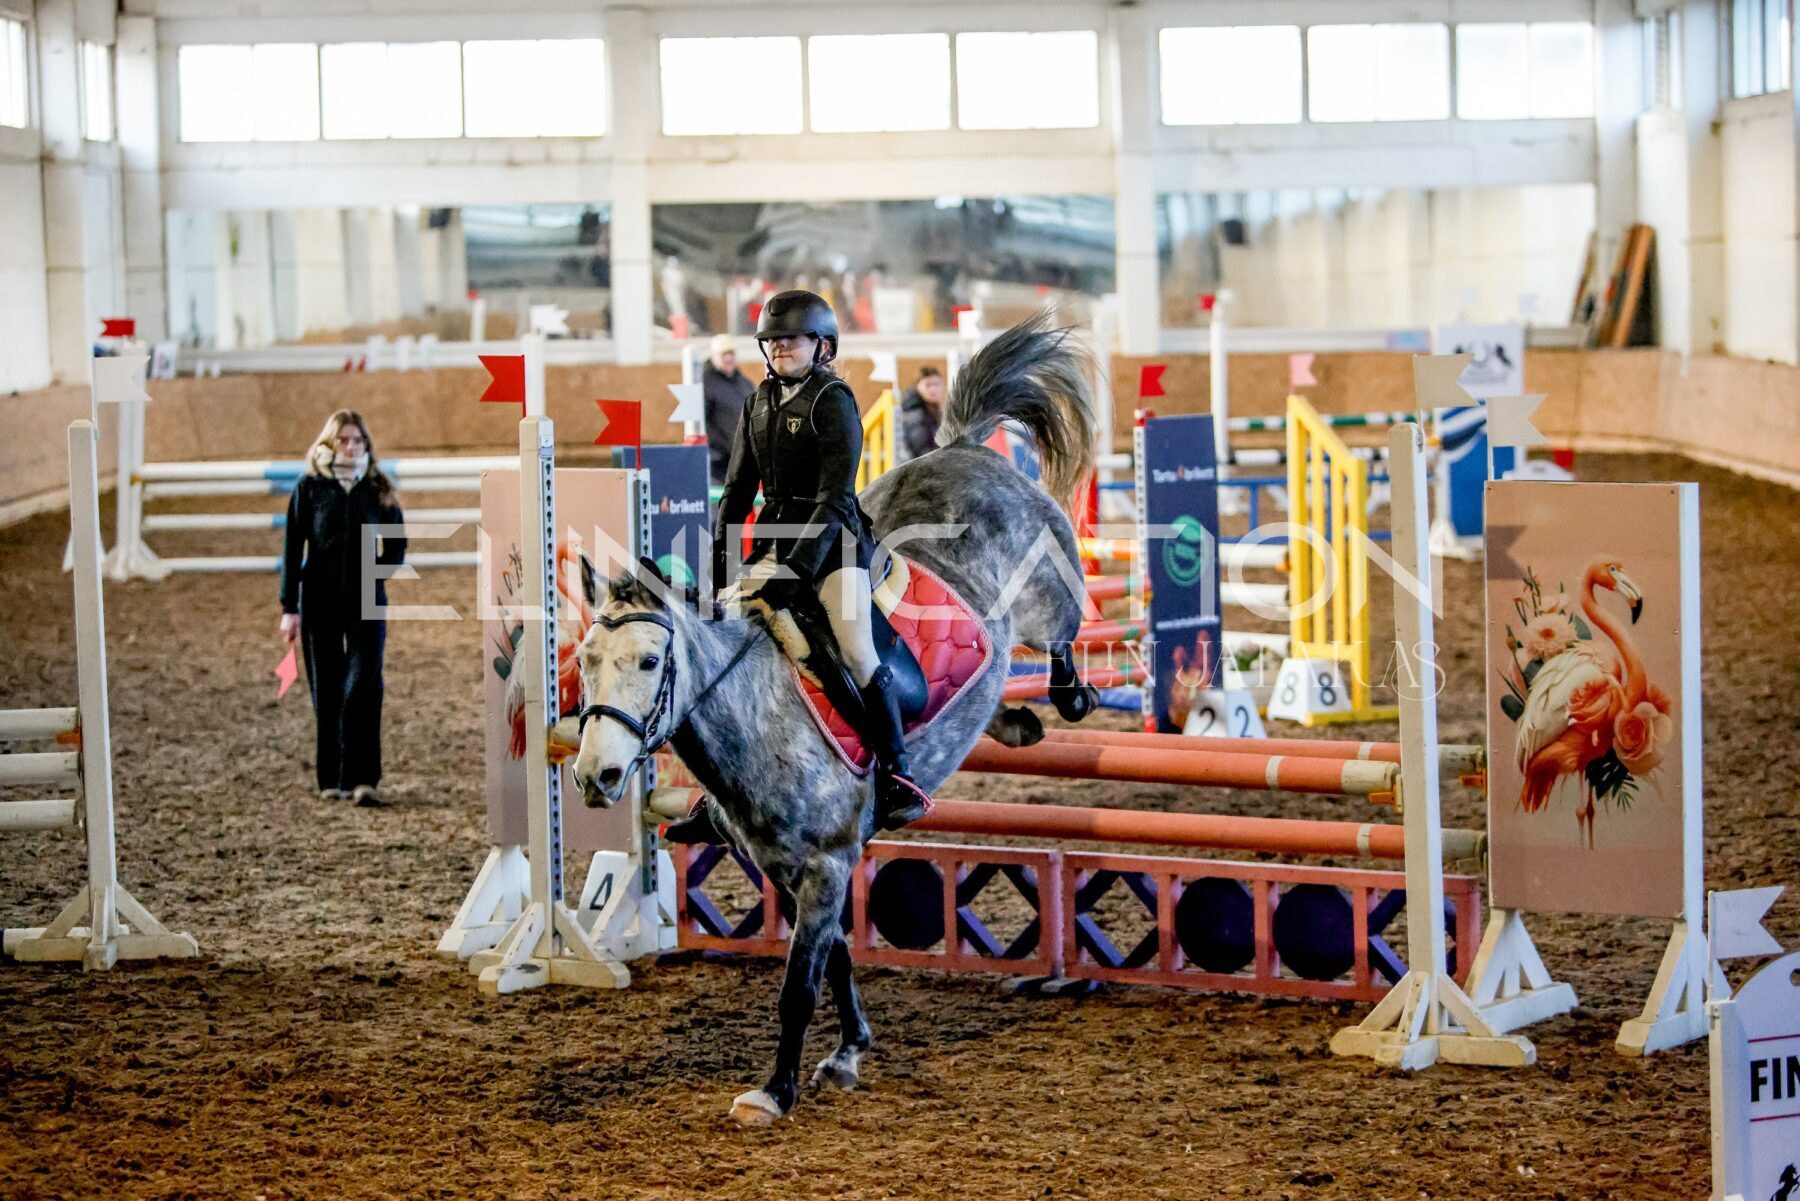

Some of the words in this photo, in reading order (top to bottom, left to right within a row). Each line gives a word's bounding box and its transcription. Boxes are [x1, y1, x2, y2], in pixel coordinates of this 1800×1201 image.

[670, 499, 704, 514] brikett
[1281, 672, 1298, 705] 8
[1318, 672, 1336, 706] 8
[1198, 705, 1215, 735] 2
[1234, 705, 1253, 737] 2
